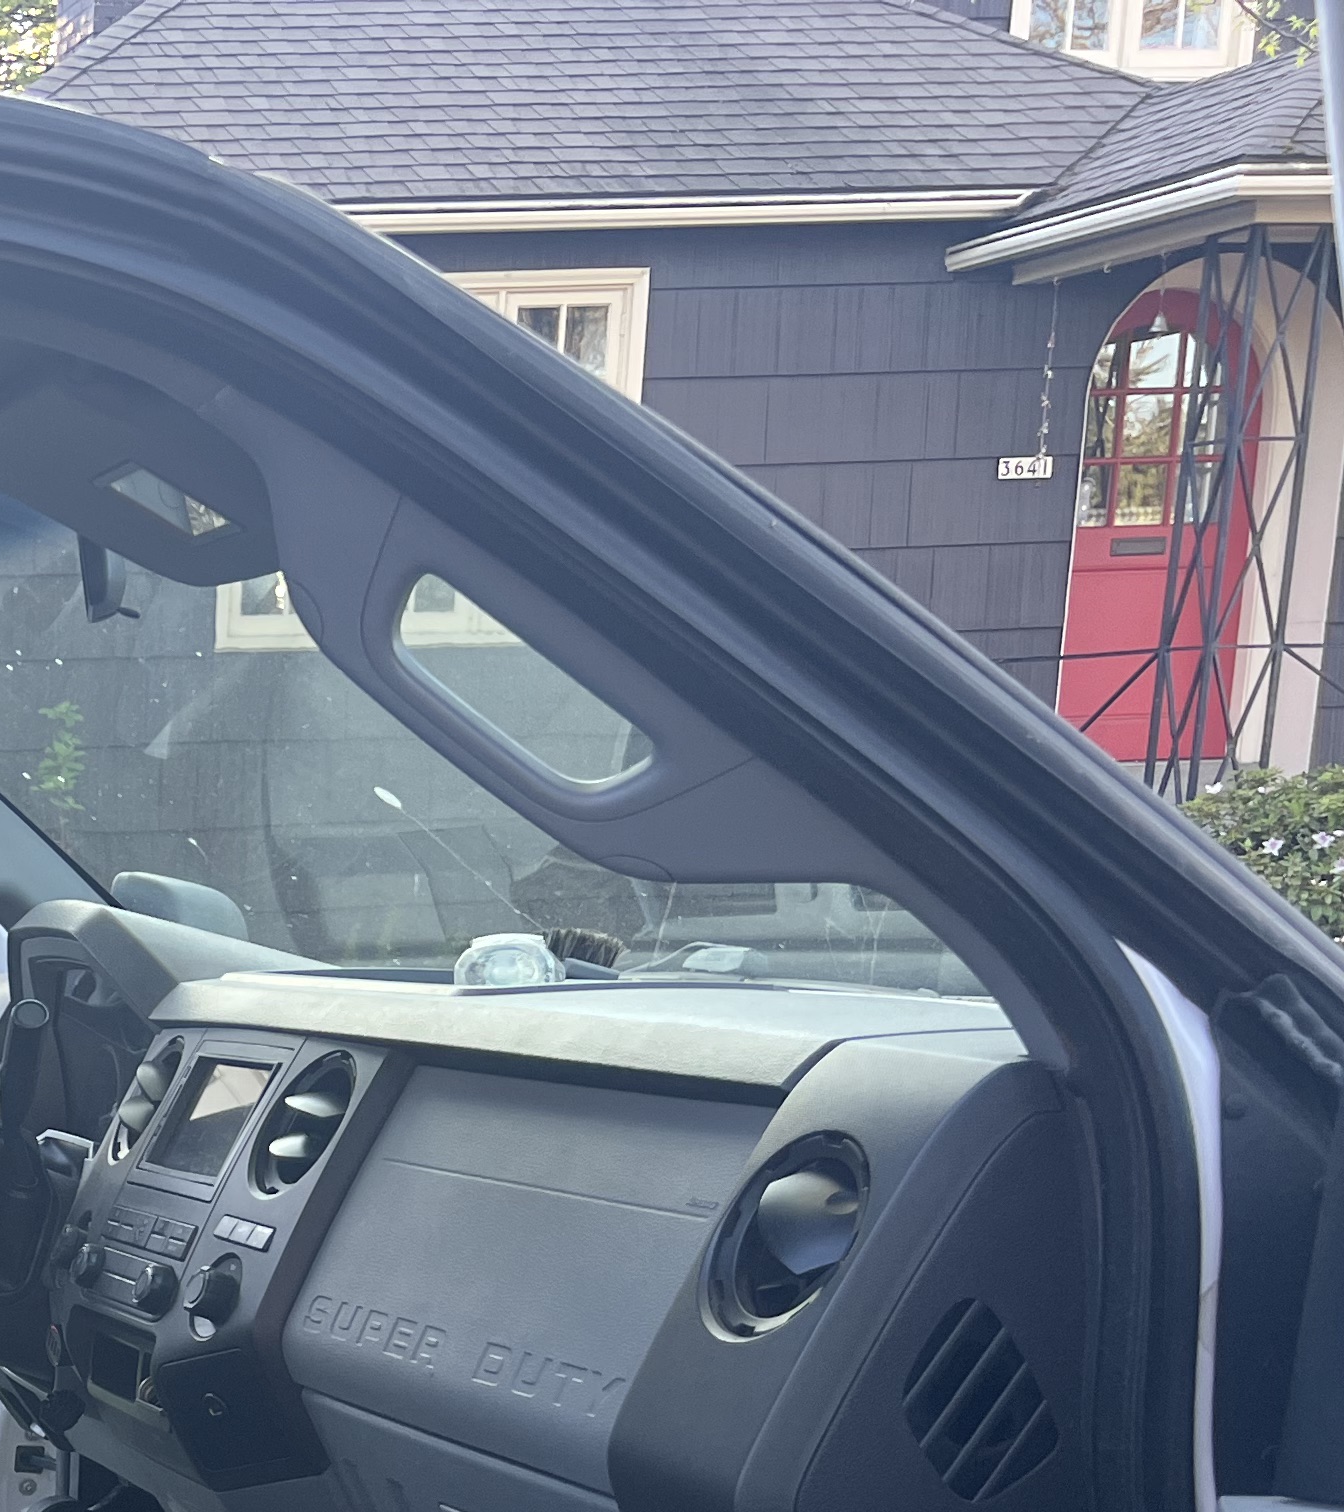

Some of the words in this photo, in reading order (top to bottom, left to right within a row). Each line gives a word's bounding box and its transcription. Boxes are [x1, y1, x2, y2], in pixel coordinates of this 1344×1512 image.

[1000, 459, 1048, 477] 3641
[302, 1294, 448, 1372] SUPER
[470, 1340, 628, 1418] DUTY
